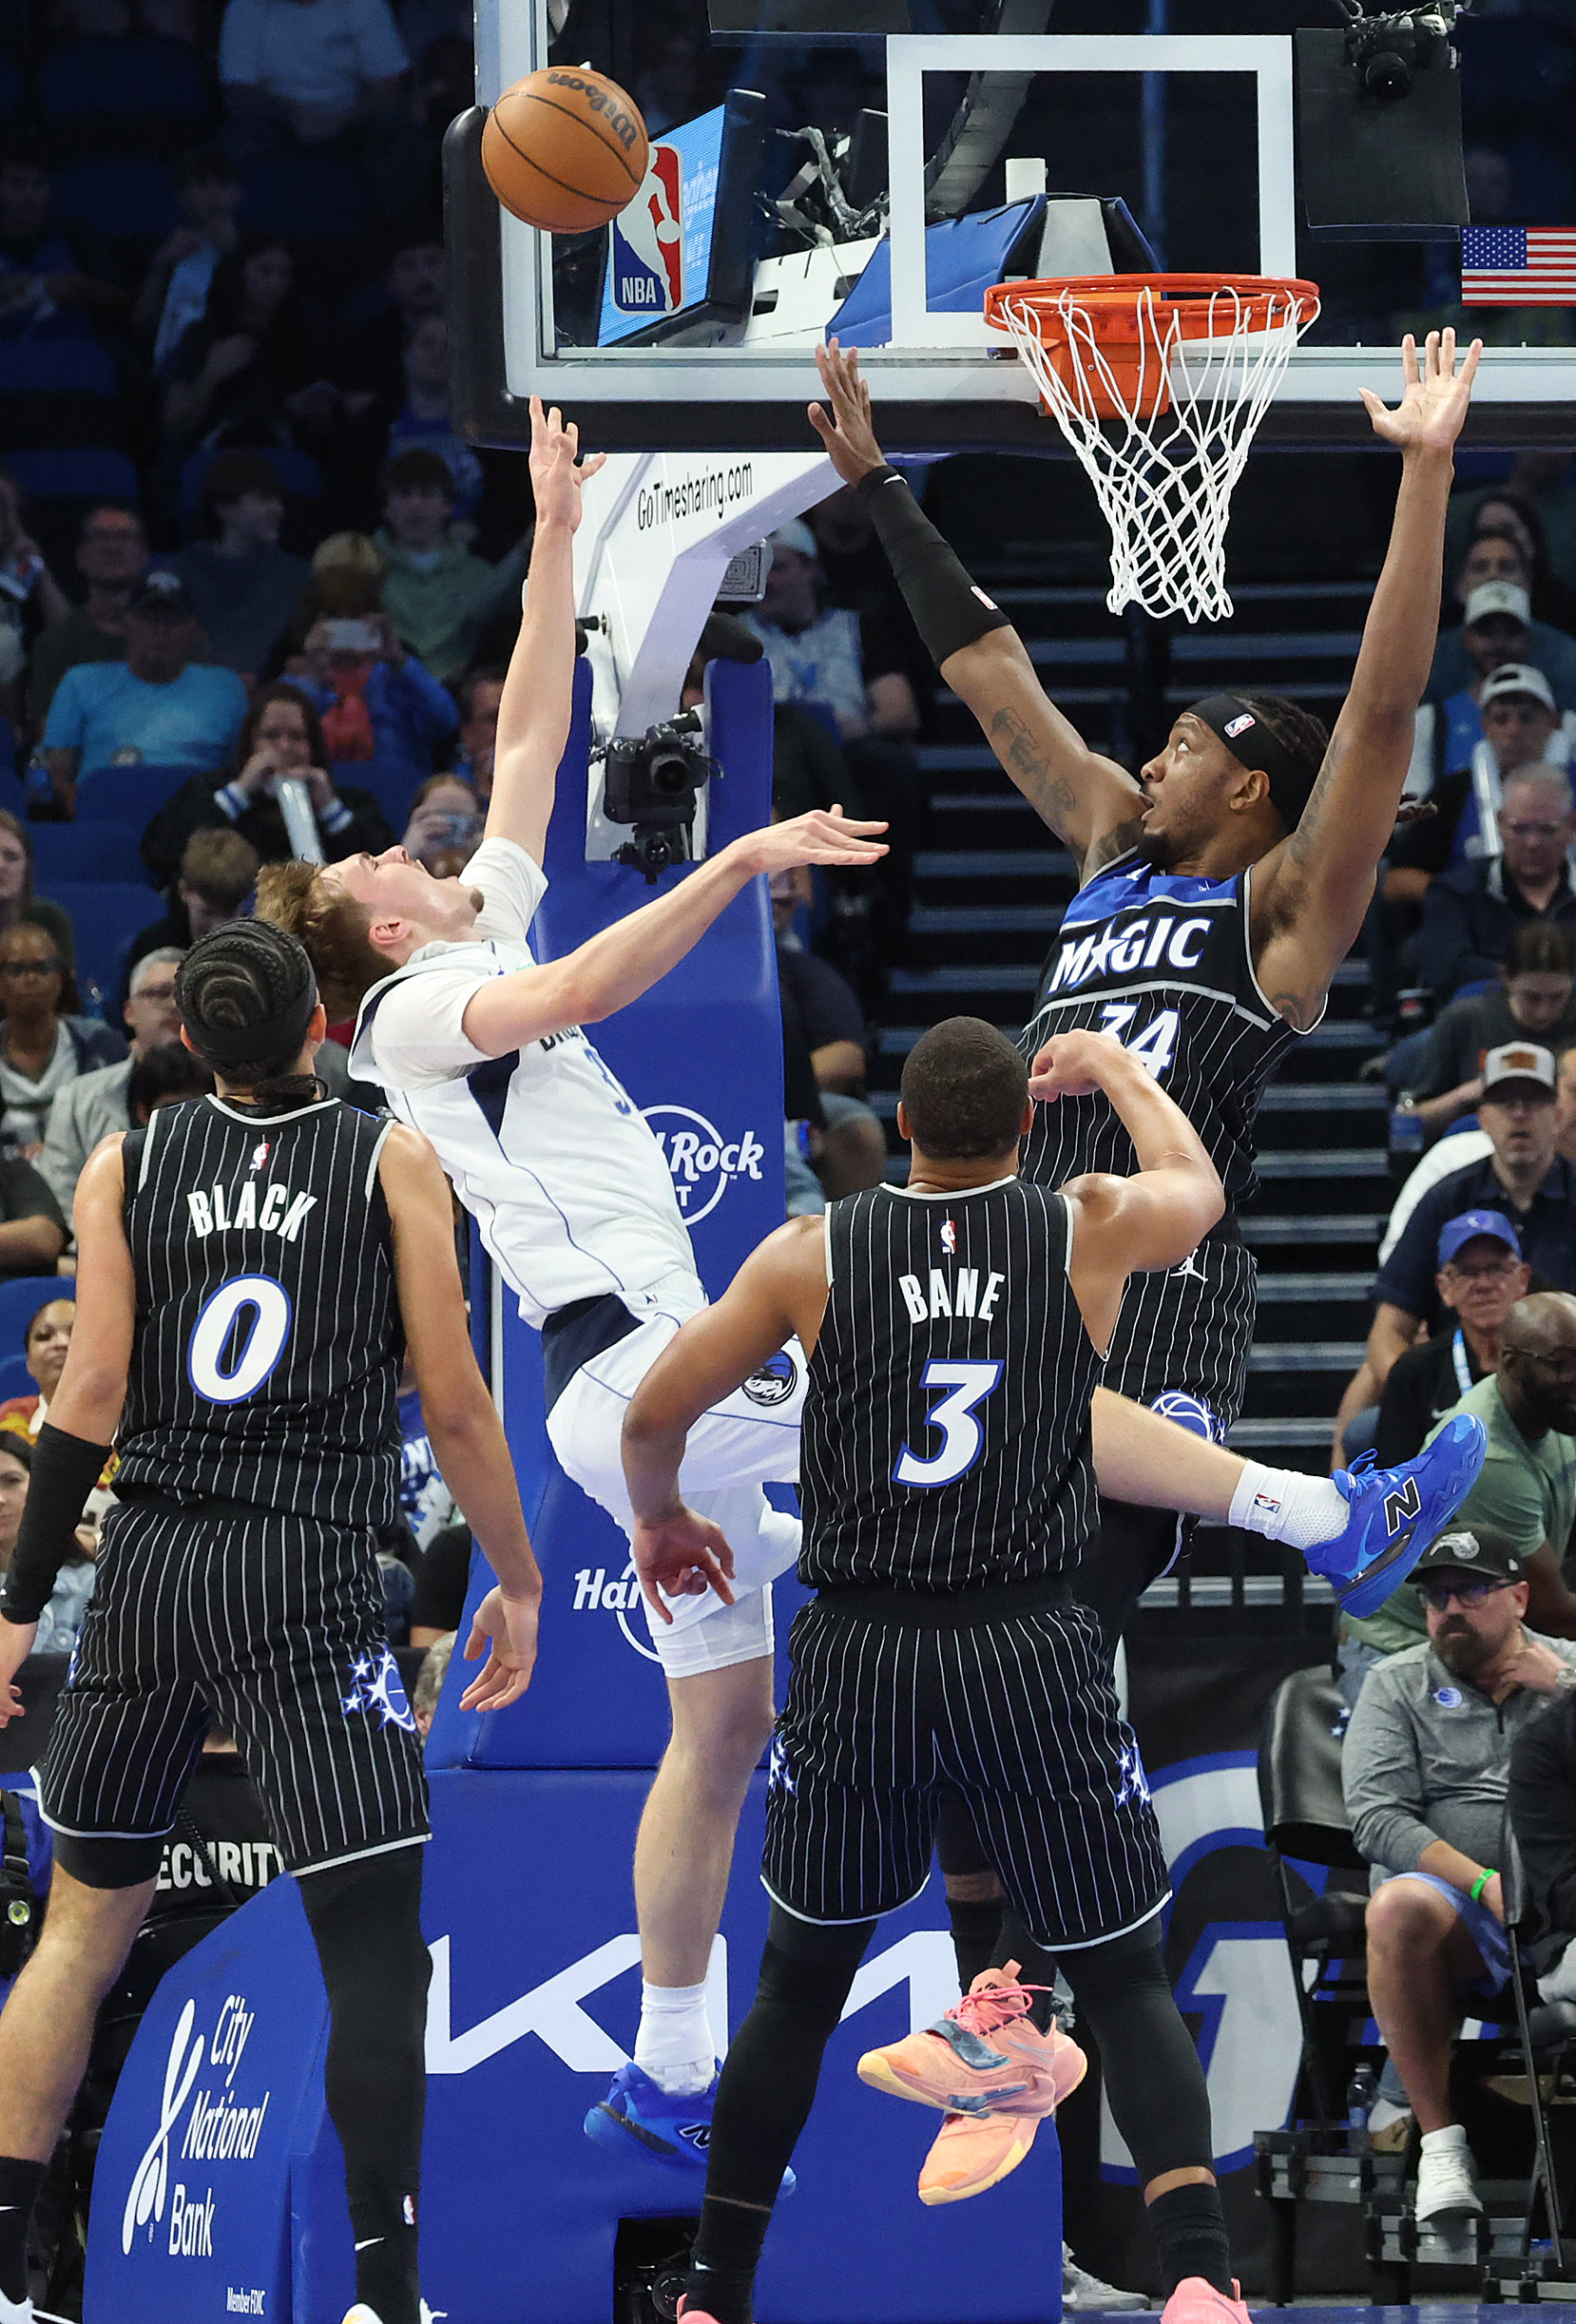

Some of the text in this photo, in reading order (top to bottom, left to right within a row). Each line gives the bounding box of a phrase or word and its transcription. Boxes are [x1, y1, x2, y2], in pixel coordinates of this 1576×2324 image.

[622, 278, 657, 303] NBA
[638, 462, 753, 530] GoTimesharing.com
[1047, 916, 1214, 994] MAGIC
[669, 1130, 764, 1181] Rock
[187, 1181, 317, 1242] BLACK
[898, 1267, 1006, 1324] BANE
[186, 1273, 292, 1406] 0
[892, 1358, 1005, 1489] 3
[572, 1568, 643, 1610] Har
[210, 1994, 255, 2088] City
[182, 2090, 270, 2160] National
[168, 2183, 216, 2257] Bank
[226, 2287, 266, 2315] Member FDIC
